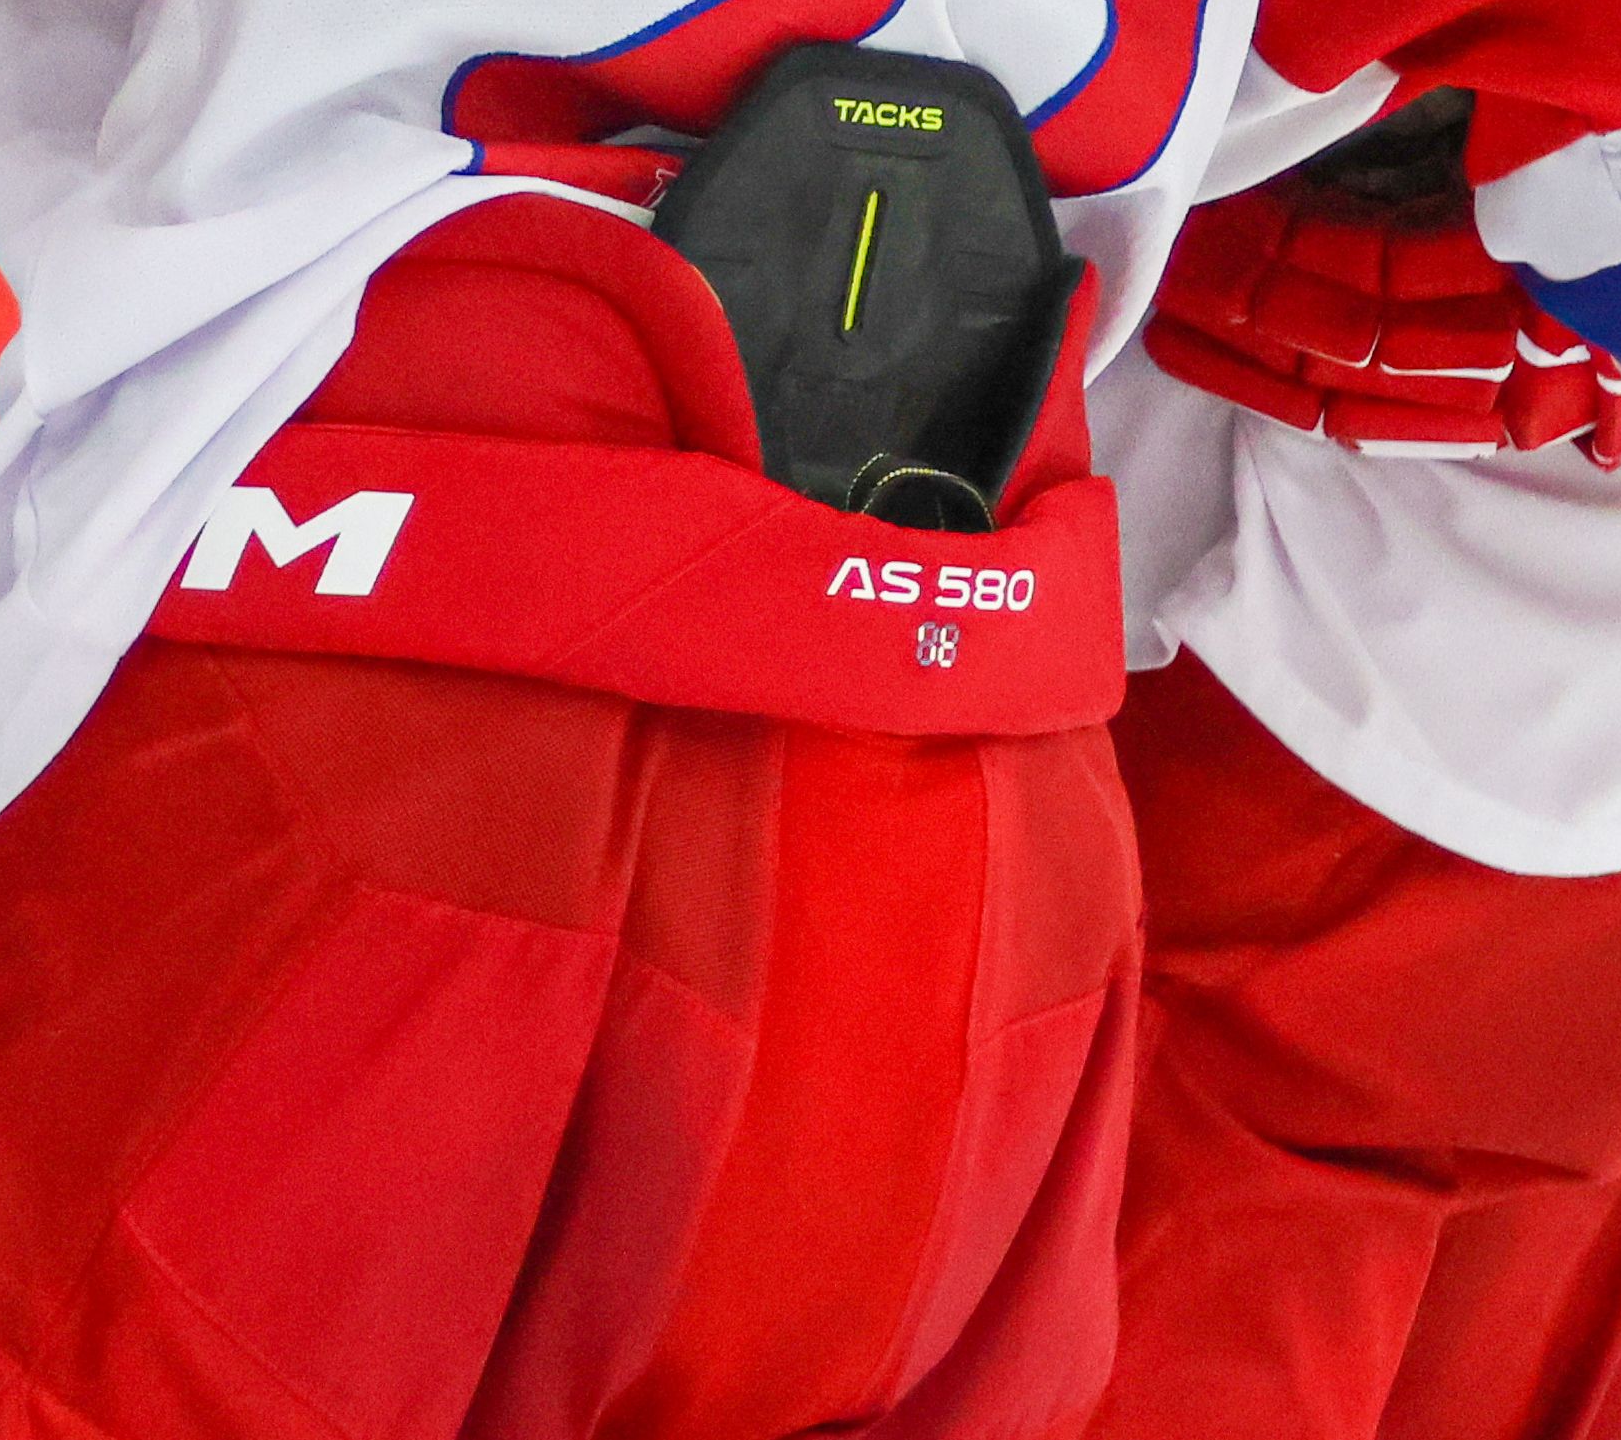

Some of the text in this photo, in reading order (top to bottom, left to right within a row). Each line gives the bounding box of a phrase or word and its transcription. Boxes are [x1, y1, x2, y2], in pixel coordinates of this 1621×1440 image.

[832, 96, 945, 133] TACKS
[178, 484, 417, 597] M
[825, 556, 1037, 613] AS 580
